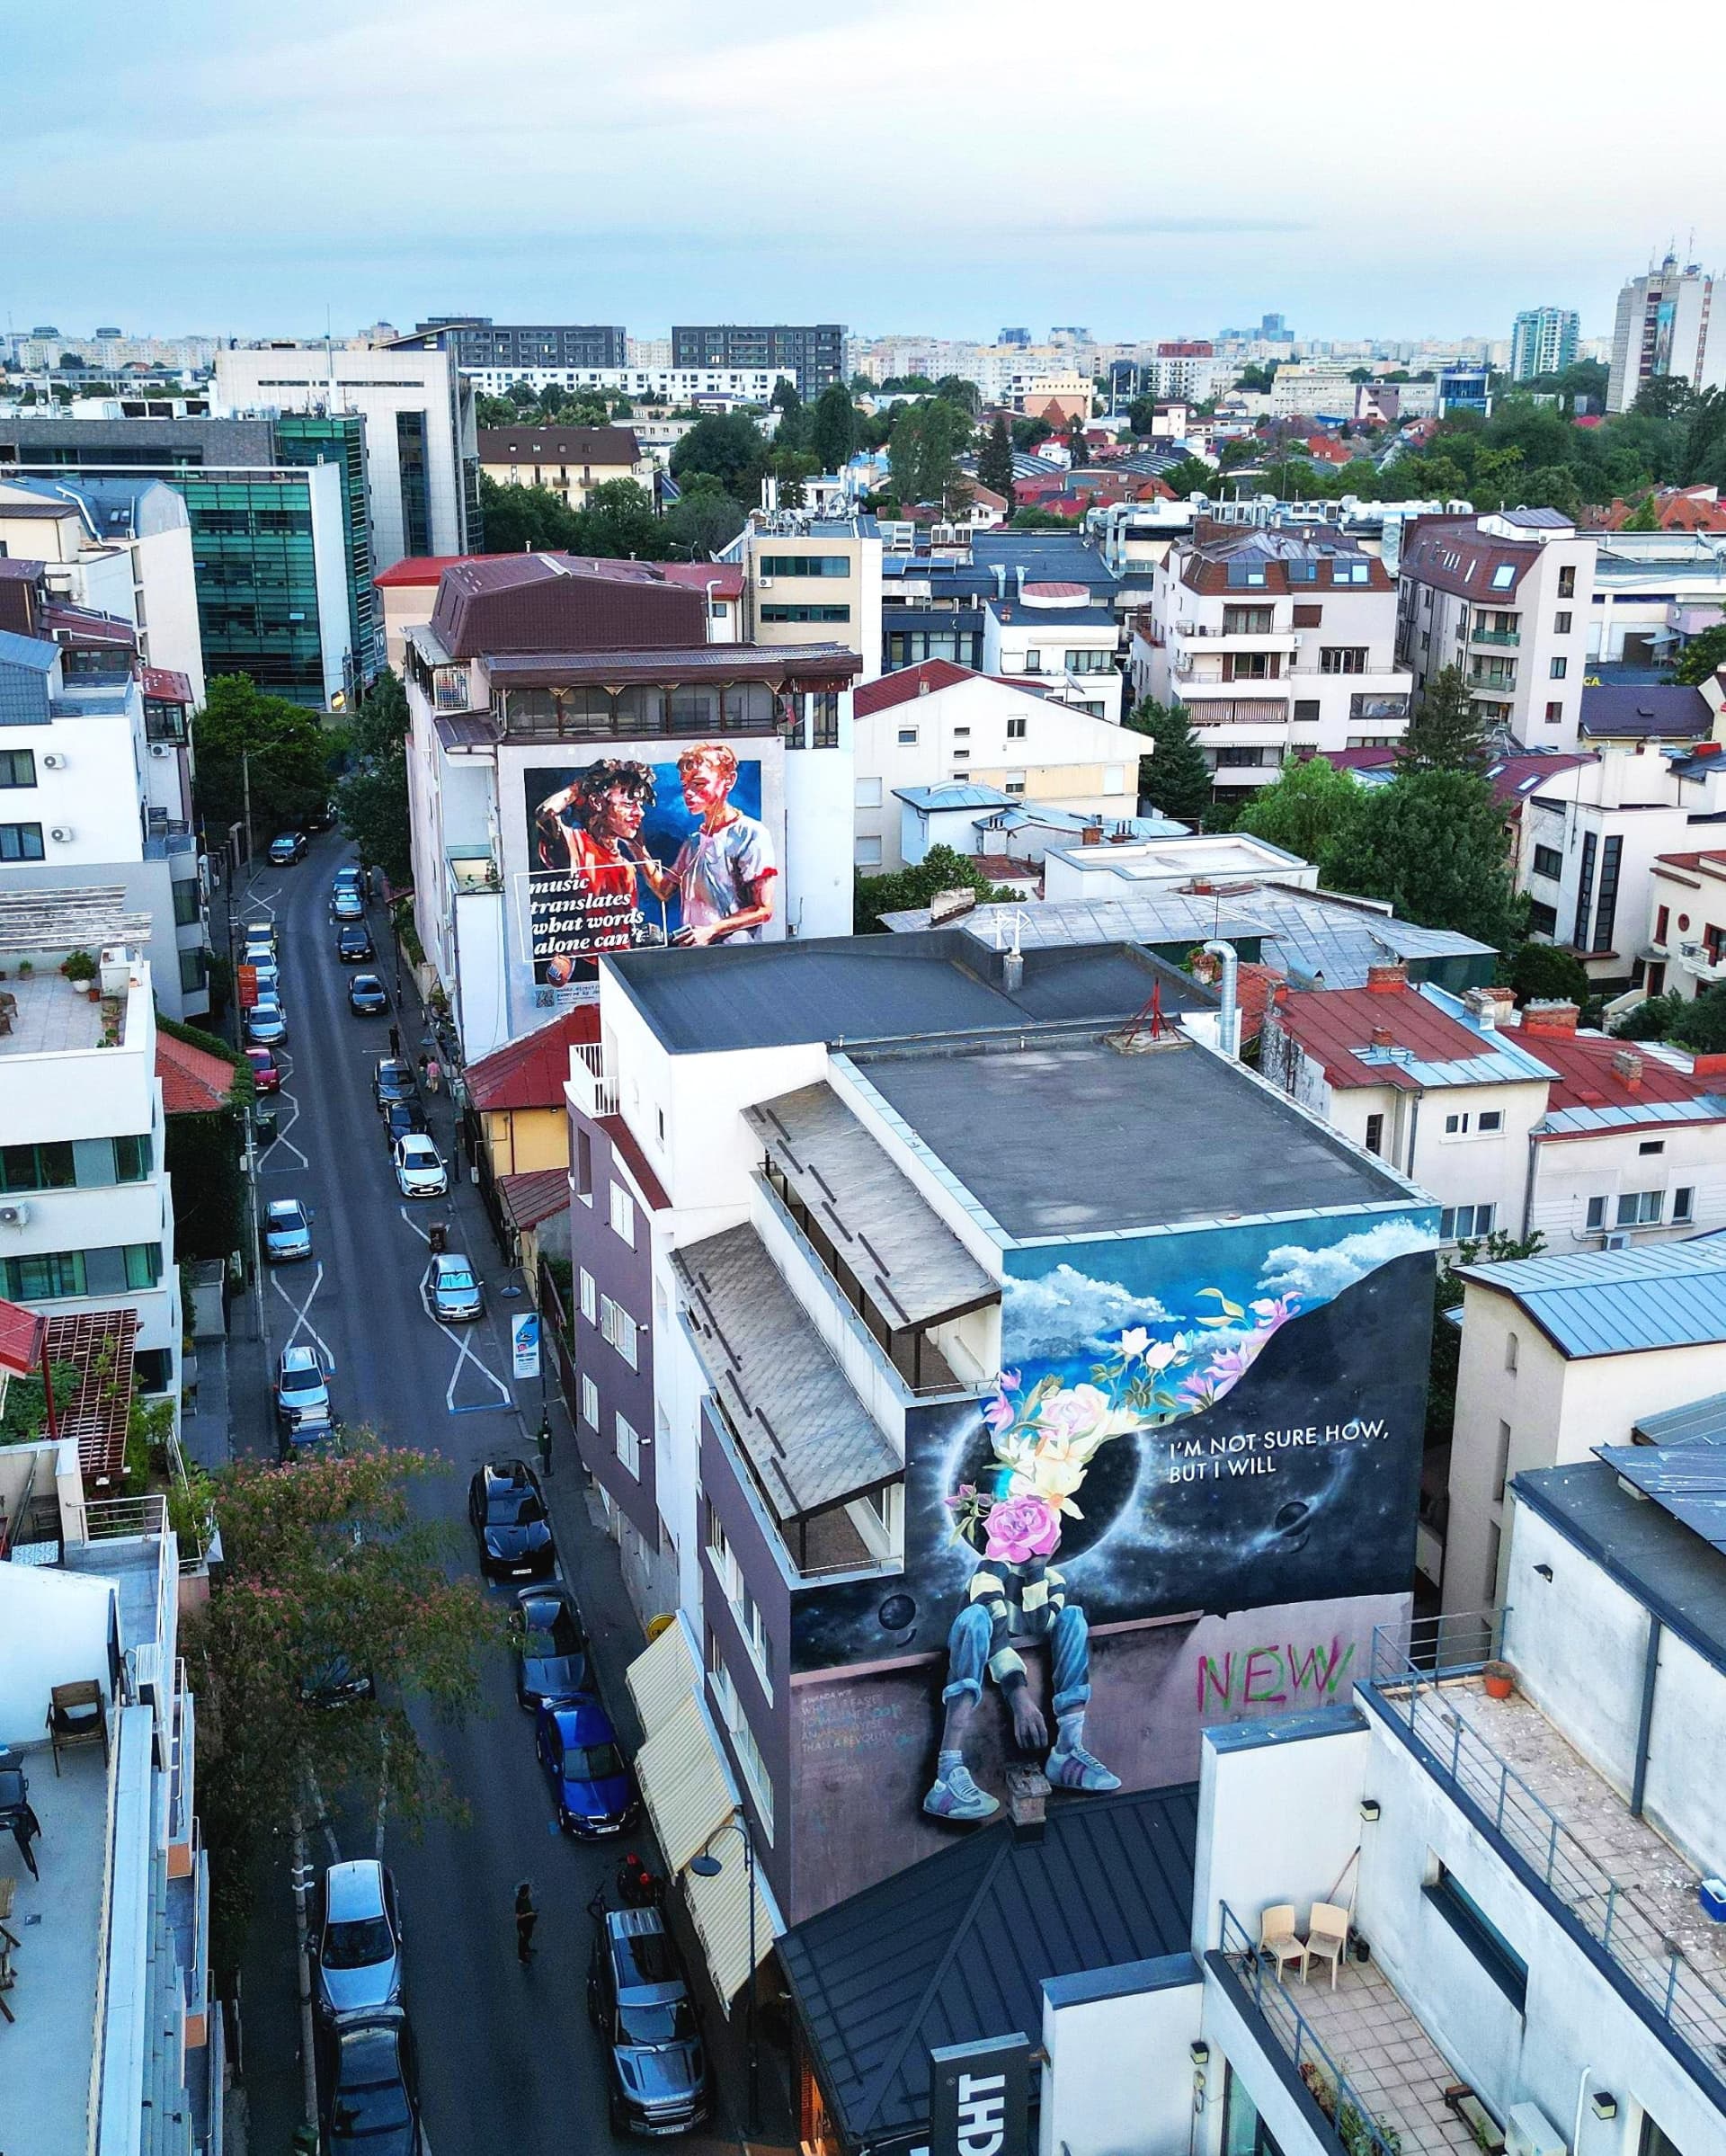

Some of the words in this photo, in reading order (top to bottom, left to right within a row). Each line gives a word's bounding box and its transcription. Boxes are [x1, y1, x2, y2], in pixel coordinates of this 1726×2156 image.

[529, 875, 590, 895] music
[530, 894, 632, 915] translates
[532, 916, 583, 935] what
[584, 908, 645, 928] words
[534, 937, 590, 955] alone
[594, 928, 644, 948] can't
[1170, 1439, 1202, 1460] I'M
[1210, 1433, 1256, 1455] NOT
[1263, 1427, 1317, 1448] SURE
[1325, 1419, 1389, 1442] HOW,
[1170, 1462, 1207, 1483] BUT
[1214, 1461, 1220, 1479] I
[1228, 1456, 1277, 1476] WILL
[1197, 1635, 1339, 1713] NEW
